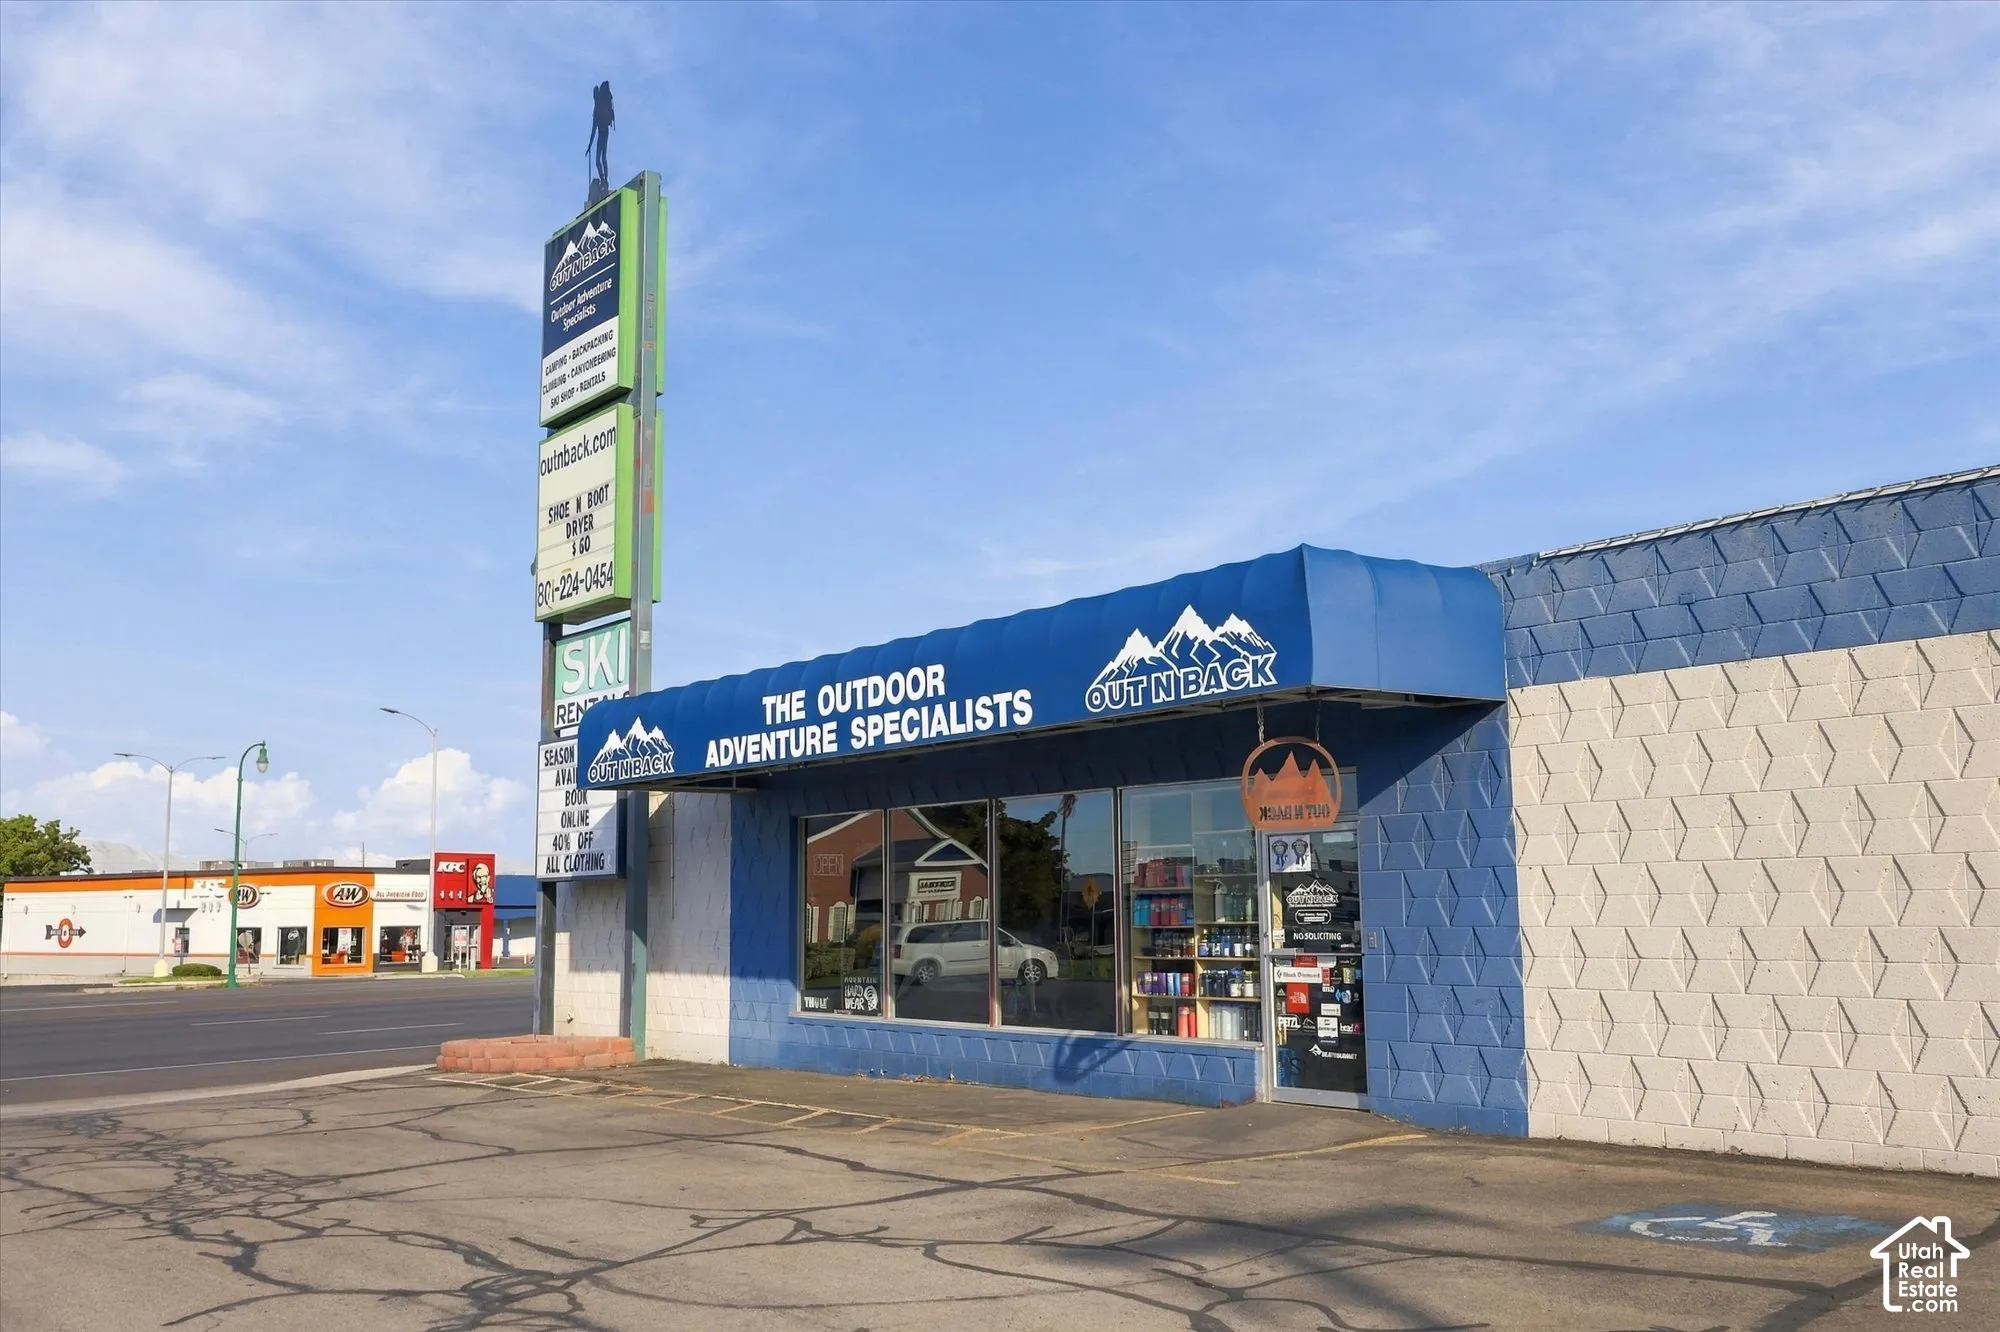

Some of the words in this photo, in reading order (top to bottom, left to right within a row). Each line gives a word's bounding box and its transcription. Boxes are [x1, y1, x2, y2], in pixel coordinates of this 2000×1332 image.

[551, 299, 576, 322] Outdoor
[576, 278, 612, 306] Adventure
[563, 303, 596, 332] Specialists
[546, 354, 567, 376] CAMPING
[572, 329, 613, 360] BACKPACKING
[543, 373, 566, 395] CLIMBING
[571, 347, 616, 378] CANYONEERING
[551, 395, 560, 409] SKI
[561, 387, 575, 403] SHOP
[580, 371, 606, 392] RENTALS
[540, 426, 616, 476] outnback.com
[548, 501, 570, 524] SHOE
[576, 496, 582, 514] N
[587, 483, 609, 510] BOOT
[566, 514, 594, 539] DRYER
[537, 561, 613, 607] 801-224-0454
[562, 627, 626, 694] SKI
[762, 690, 806, 725] THE
[818, 663, 945, 716] OUTDOOR
[1085, 676, 1147, 713] OUT
[1180, 653, 1278, 699] BACK
[705, 721, 838, 768] ADVENTURE
[851, 689, 1032, 749] SPECIALISTS
[544, 745, 575, 767] SEASON
[565, 789, 588, 806] BOOK
[561, 810, 589, 828] ONLINE
[553, 834, 570, 851] 40%
[577, 831, 593, 850] OFF
[437, 861, 466, 873] KFC
[546, 856, 560, 874] ALL
[564, 852, 605, 873] CLOTHING
[333, 887, 362, 901] A&W
[1293, 932, 1304, 940] NO
[1305, 932, 1342, 941] SOLICITING
[844, 976, 877, 984] MOUNTAIN
[844, 985, 863, 997] HARD
[804, 996, 828, 1009] THULE
[844, 997, 865, 1010] WEAR
